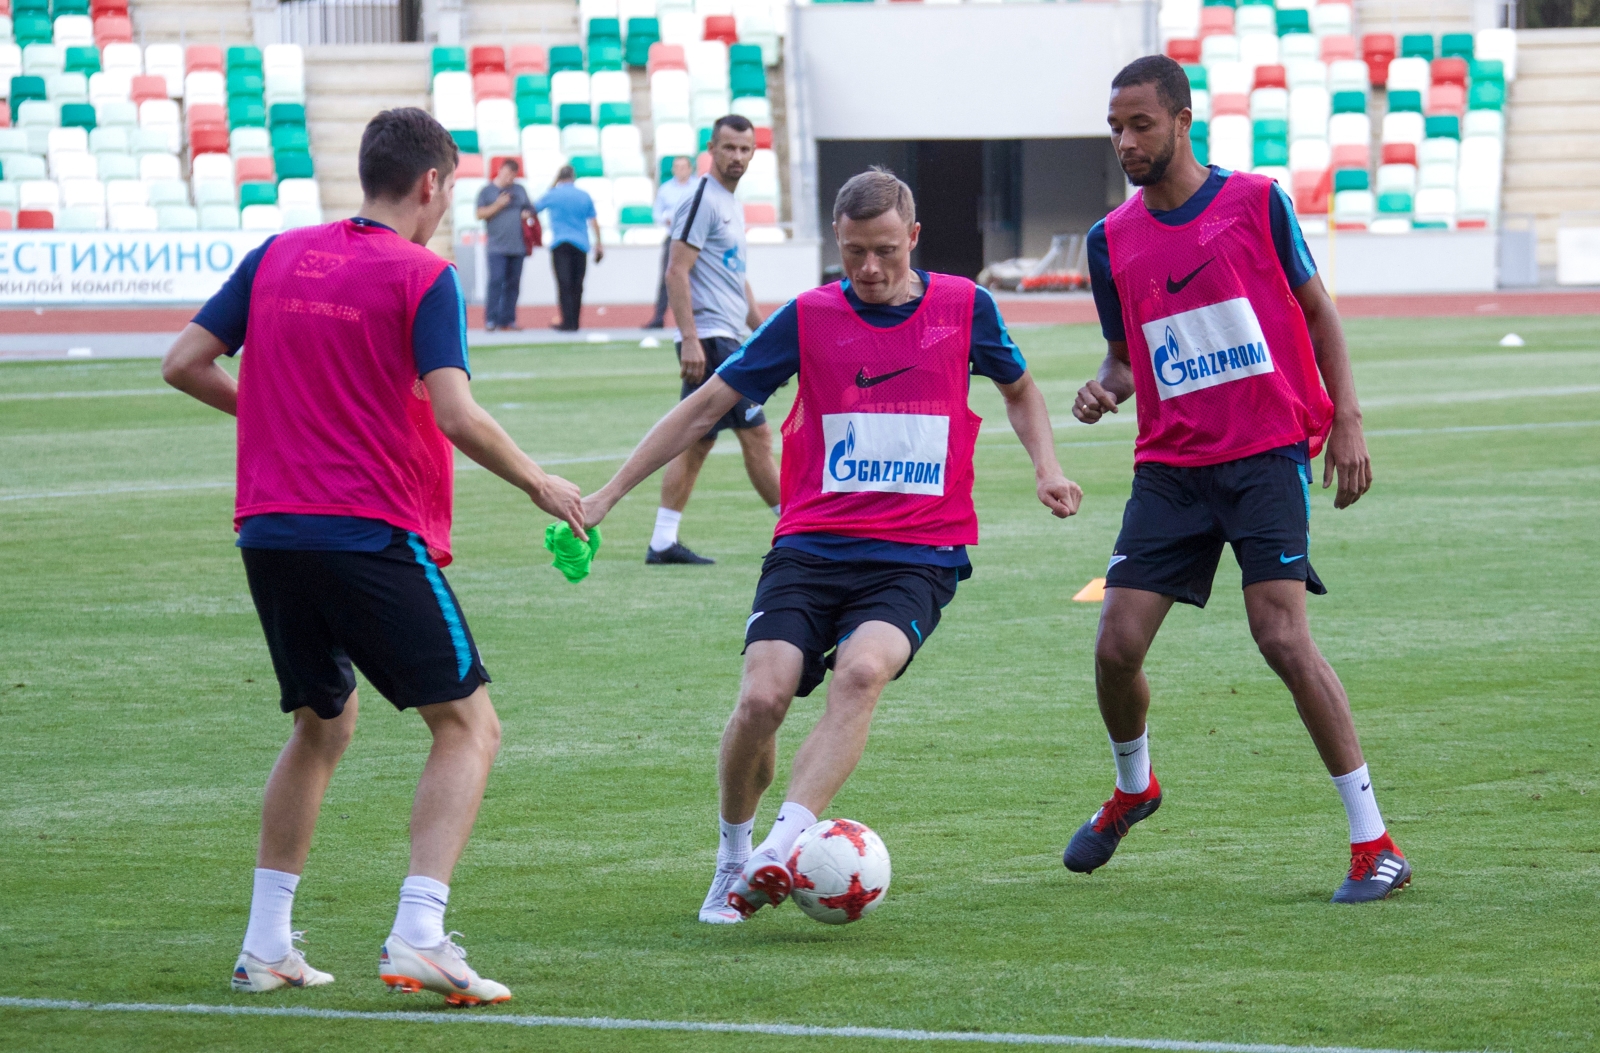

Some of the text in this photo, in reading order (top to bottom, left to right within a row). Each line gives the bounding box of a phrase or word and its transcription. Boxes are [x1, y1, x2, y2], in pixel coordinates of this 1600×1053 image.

[71, 279, 174, 295] комплекс
[1187, 342, 1267, 381] GAZPROM
[857, 459, 940, 485] GAZPROM
